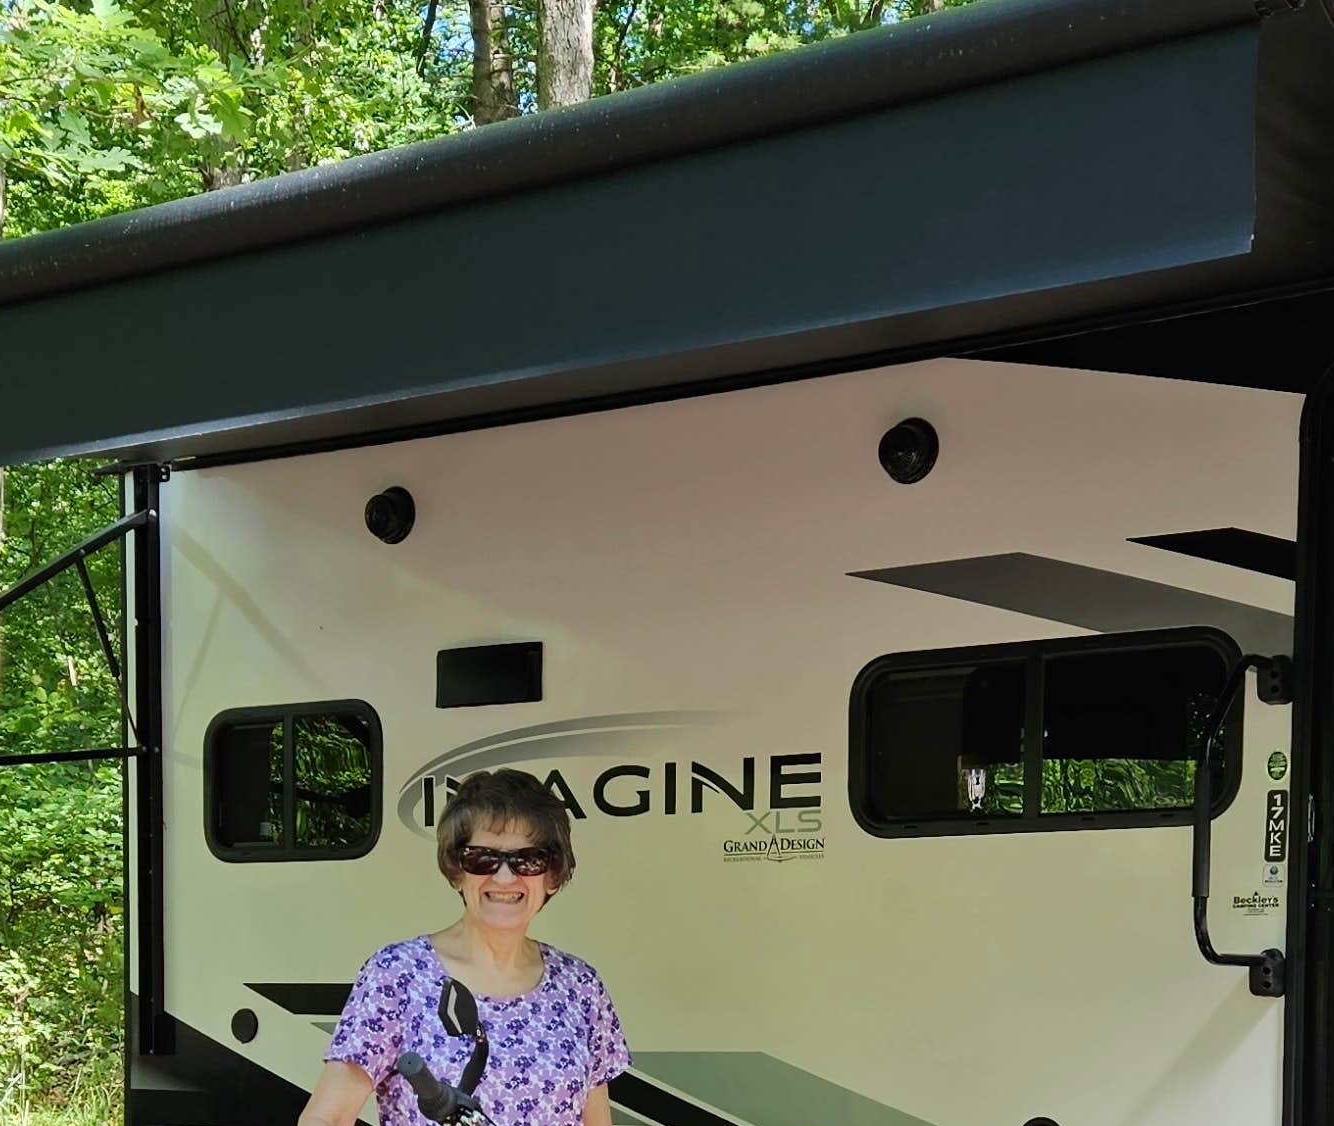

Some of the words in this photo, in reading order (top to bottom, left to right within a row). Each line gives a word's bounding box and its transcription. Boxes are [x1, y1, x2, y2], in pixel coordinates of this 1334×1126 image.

[423, 752, 823, 828] IAGINE
[744, 809, 823, 835] XLS
[1268, 793, 1286, 857] 17MKE
[723, 840, 768, 853] GRAND
[780, 838, 825, 851] DESIGN
